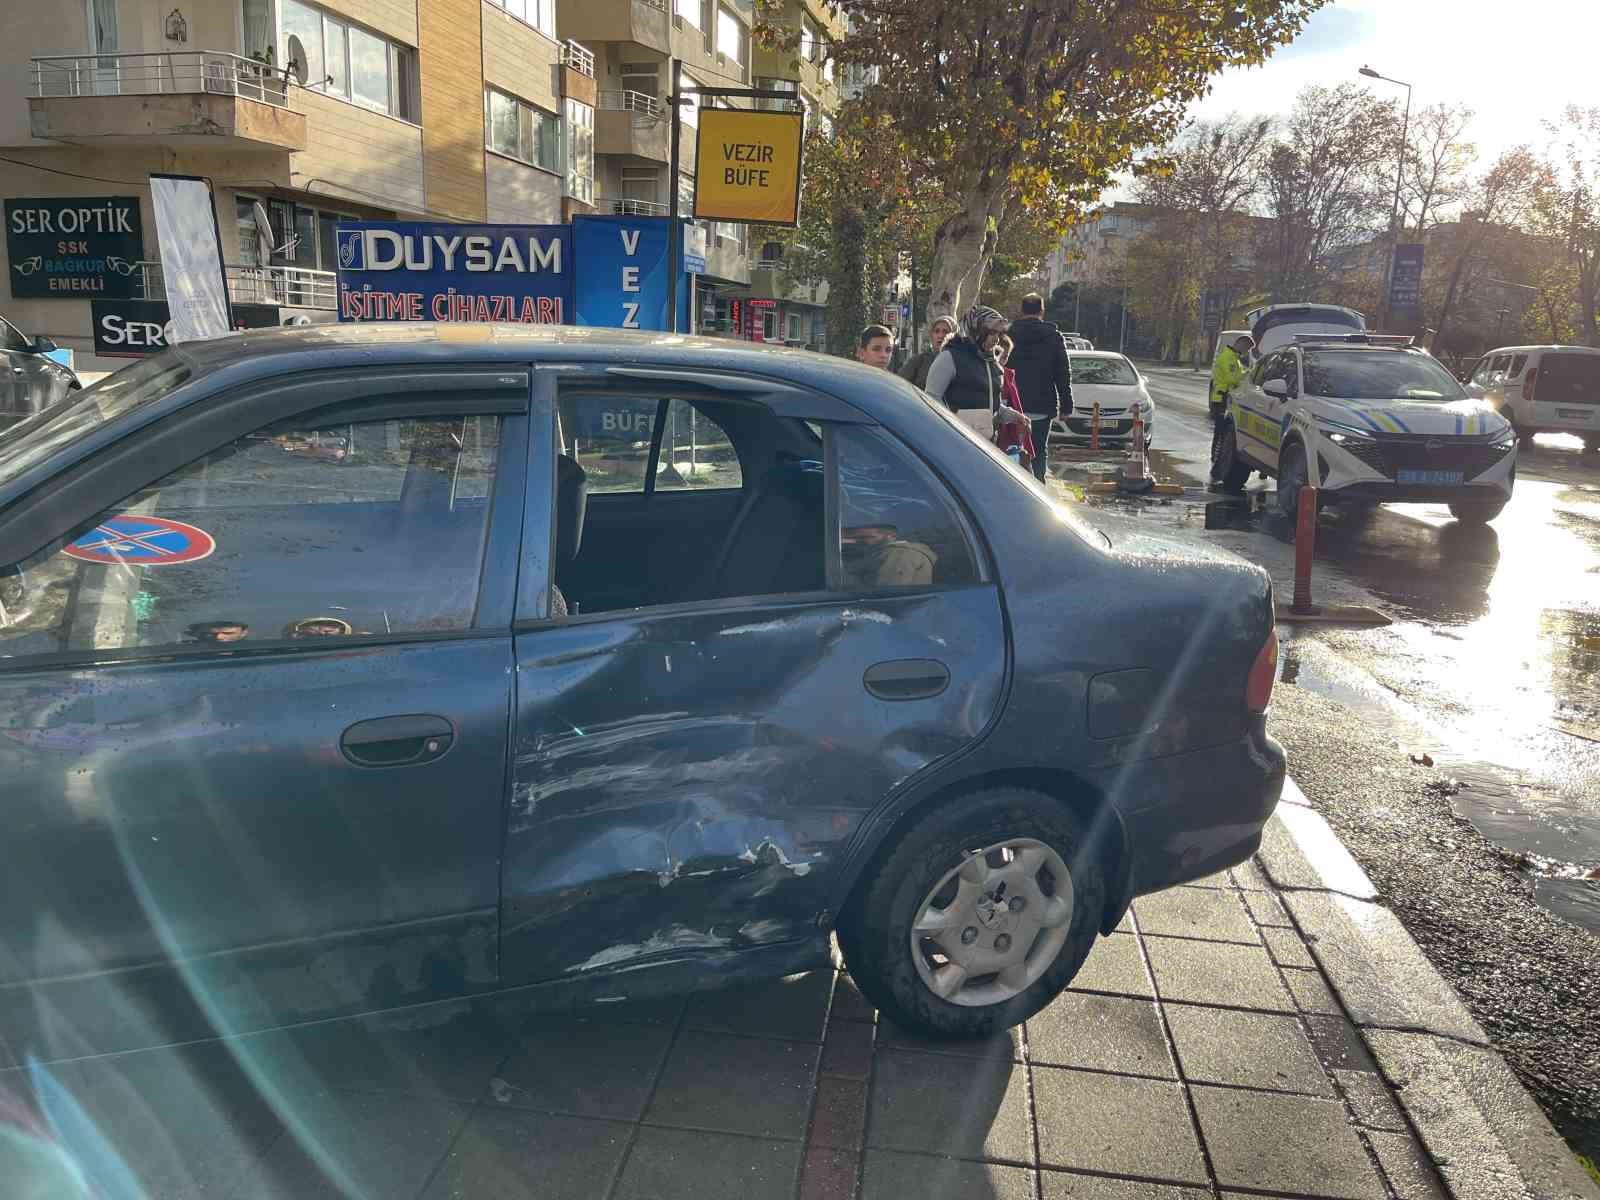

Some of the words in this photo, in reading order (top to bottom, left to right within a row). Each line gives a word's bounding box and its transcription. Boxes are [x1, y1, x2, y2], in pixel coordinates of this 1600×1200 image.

[722, 141, 774, 163] VEZİR
[724, 165, 770, 187] BÜFE
[12, 208, 55, 233] SER
[58, 201, 133, 233] OPTİK
[57, 241, 89, 255] SSK
[366, 229, 563, 274] DUYSAM
[45, 257, 105, 273] BAĞKUR
[49, 275, 105, 291] EMEKLİ
[341, 283, 425, 323] İŞİTME
[431, 287, 564, 326] CİHAZLARI
